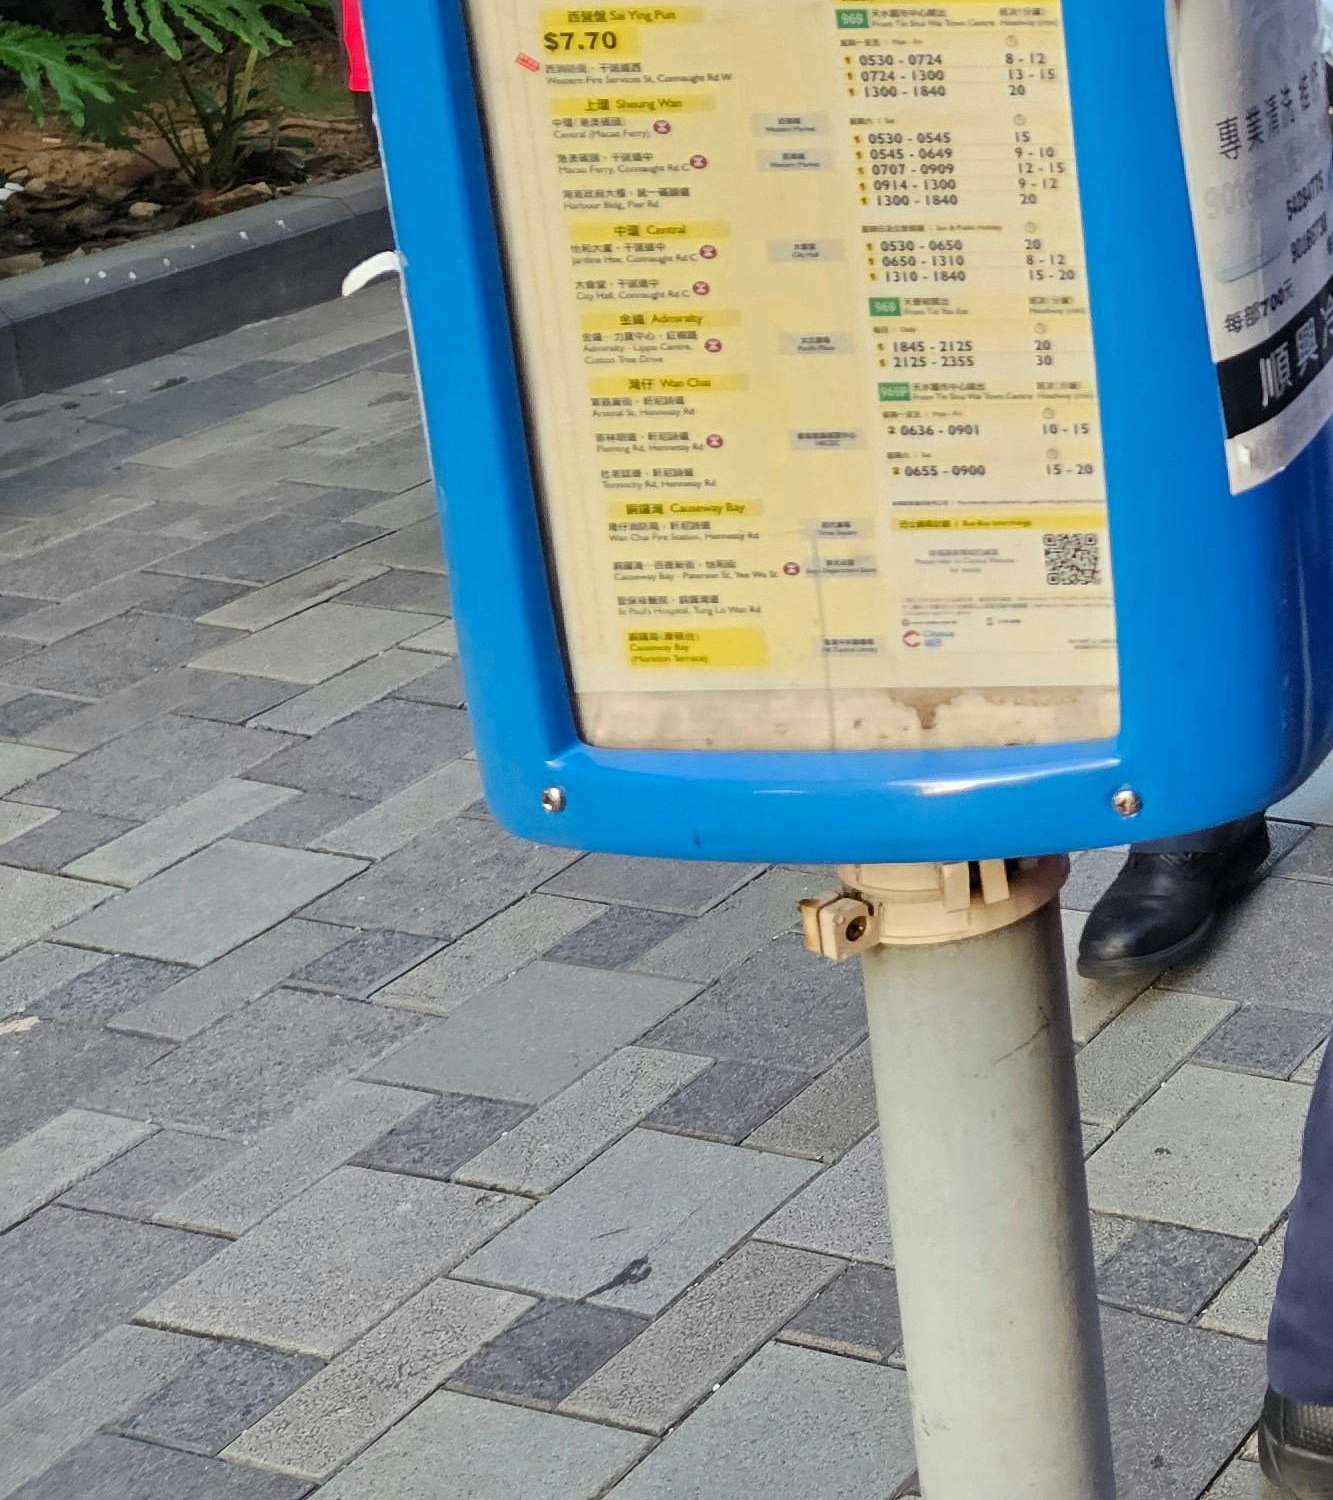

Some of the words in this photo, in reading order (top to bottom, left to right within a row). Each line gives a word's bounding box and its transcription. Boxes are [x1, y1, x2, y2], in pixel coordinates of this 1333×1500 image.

[610, 11, 625, 20] Sai
[627, 10, 652, 22] Ying
[654, 10, 675, 20] Pun
[543, 31, 617, 52] $7.70
[859, 54, 893, 66] 0530
[908, 54, 942, 66] 0724
[861, 70, 894, 81] 0724
[912, 70, 944, 81] 1300
[865, 86, 897, 97] 1300
[914, 86, 945, 97] 1840
[616, 99, 655, 110] Sheung
[658, 98, 682, 108] Wan
[868, 132, 902, 144] 0530
[917, 132, 950, 144] 0545
[870, 148, 904, 160] 0545
[918, 148, 952, 160] 0649
[872, 164, 905, 175] 0707
[920, 164, 954, 175] 0909
[874, 179, 908, 191] 0914
[924, 179, 956, 191] 1300
[877, 195, 909, 206] 1300
[925, 195, 958, 206] 1840
[646, 224, 686, 235] Central
[880, 240, 914, 251] 0530
[928, 240, 962, 251] 0650
[882, 255, 916, 267] 0650
[932, 255, 964, 267] 1310
[886, 271, 917, 282] 1310
[934, 271, 965, 282] 1840
[652, 314, 703, 326] Admiralty
[893, 341, 924, 352] 1845
[940, 341, 972, 352] 2125
[894, 356, 926, 367] 2125
[942, 356, 974, 367] 2355
[660, 379, 684, 388] Wan
[687, 378, 711, 388] Chai
[901, 425, 934, 435] 0636
[948, 425, 979, 435] 0901
[904, 465, 938, 476] 0655
[952, 465, 985, 476] 0900
[670, 503, 723, 514] Causeway
[726, 503, 745, 514] Bay
